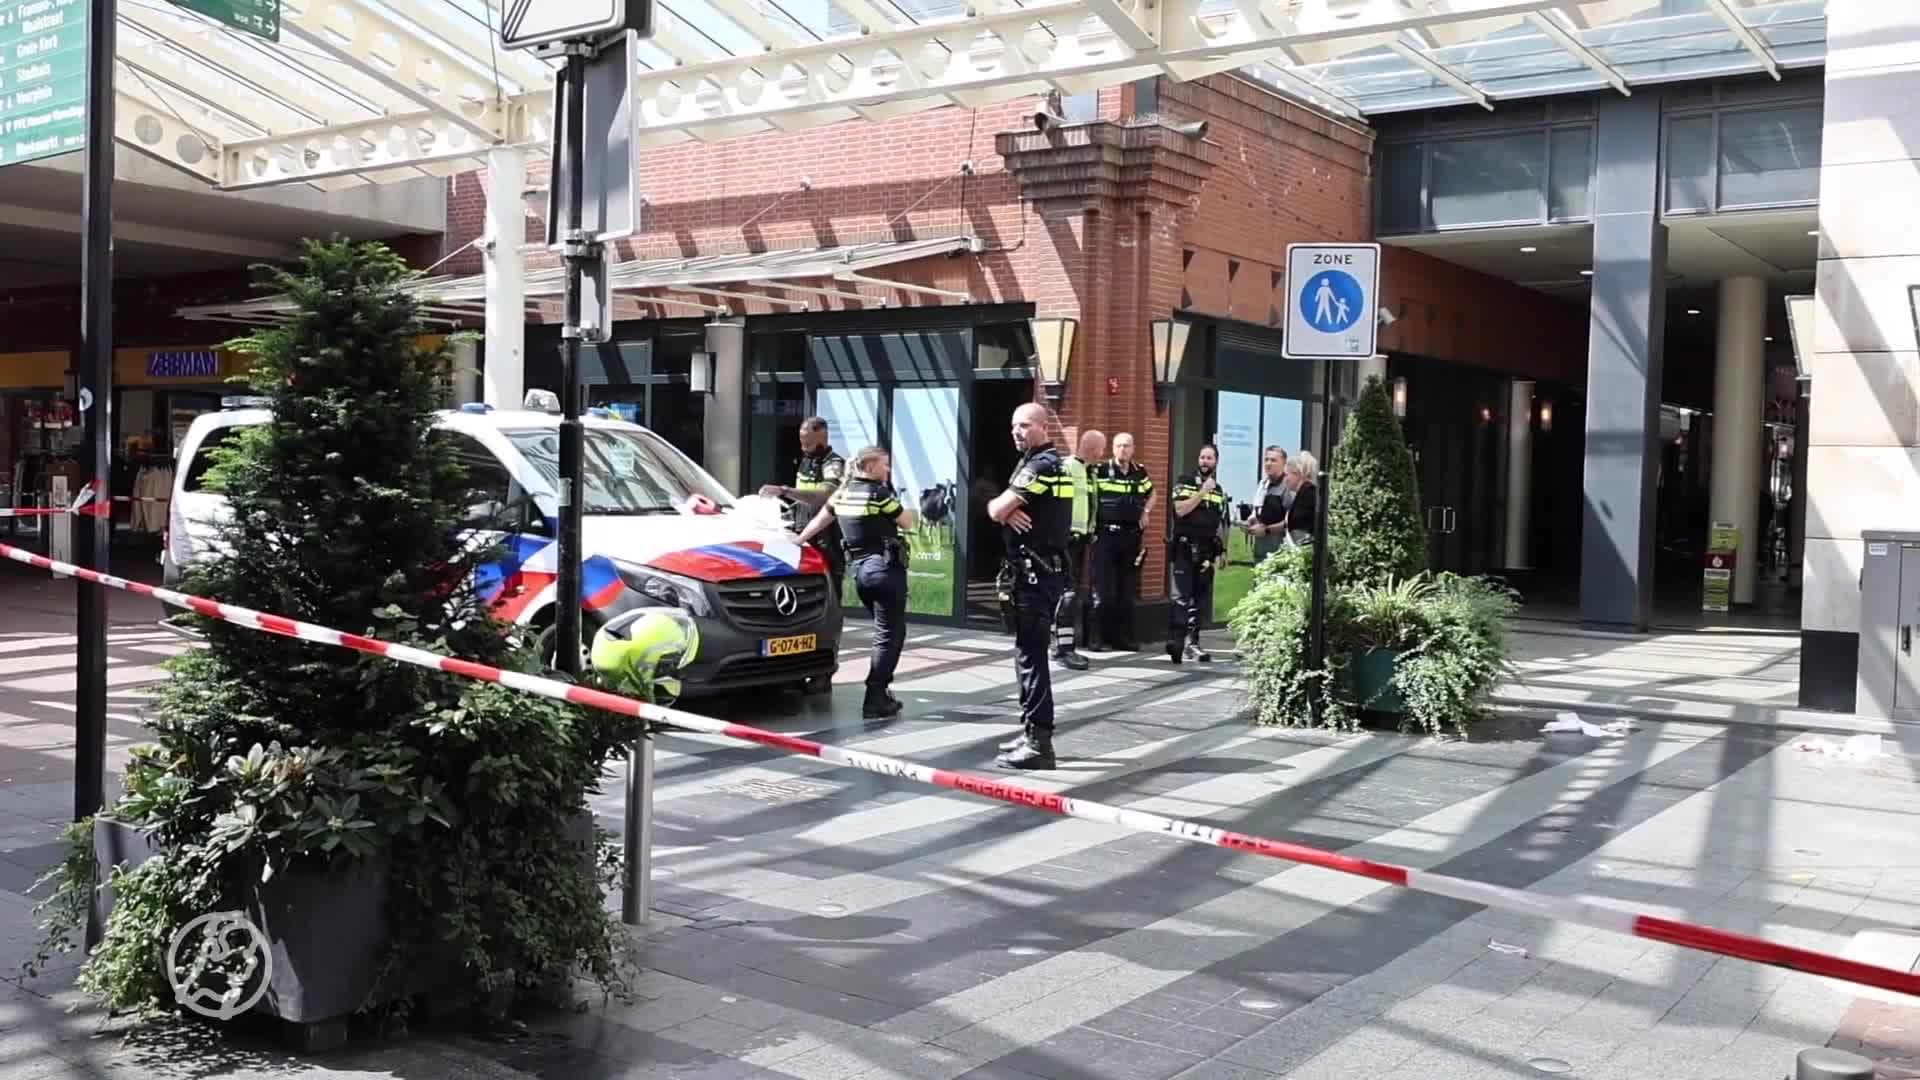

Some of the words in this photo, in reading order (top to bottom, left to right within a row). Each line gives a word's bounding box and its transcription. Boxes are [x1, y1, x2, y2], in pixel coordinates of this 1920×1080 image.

[1312, 253, 1353, 265] ZONE
[150, 351, 219, 377] ZEEMAN
[770, 635, 814, 654] G-074-HZ
